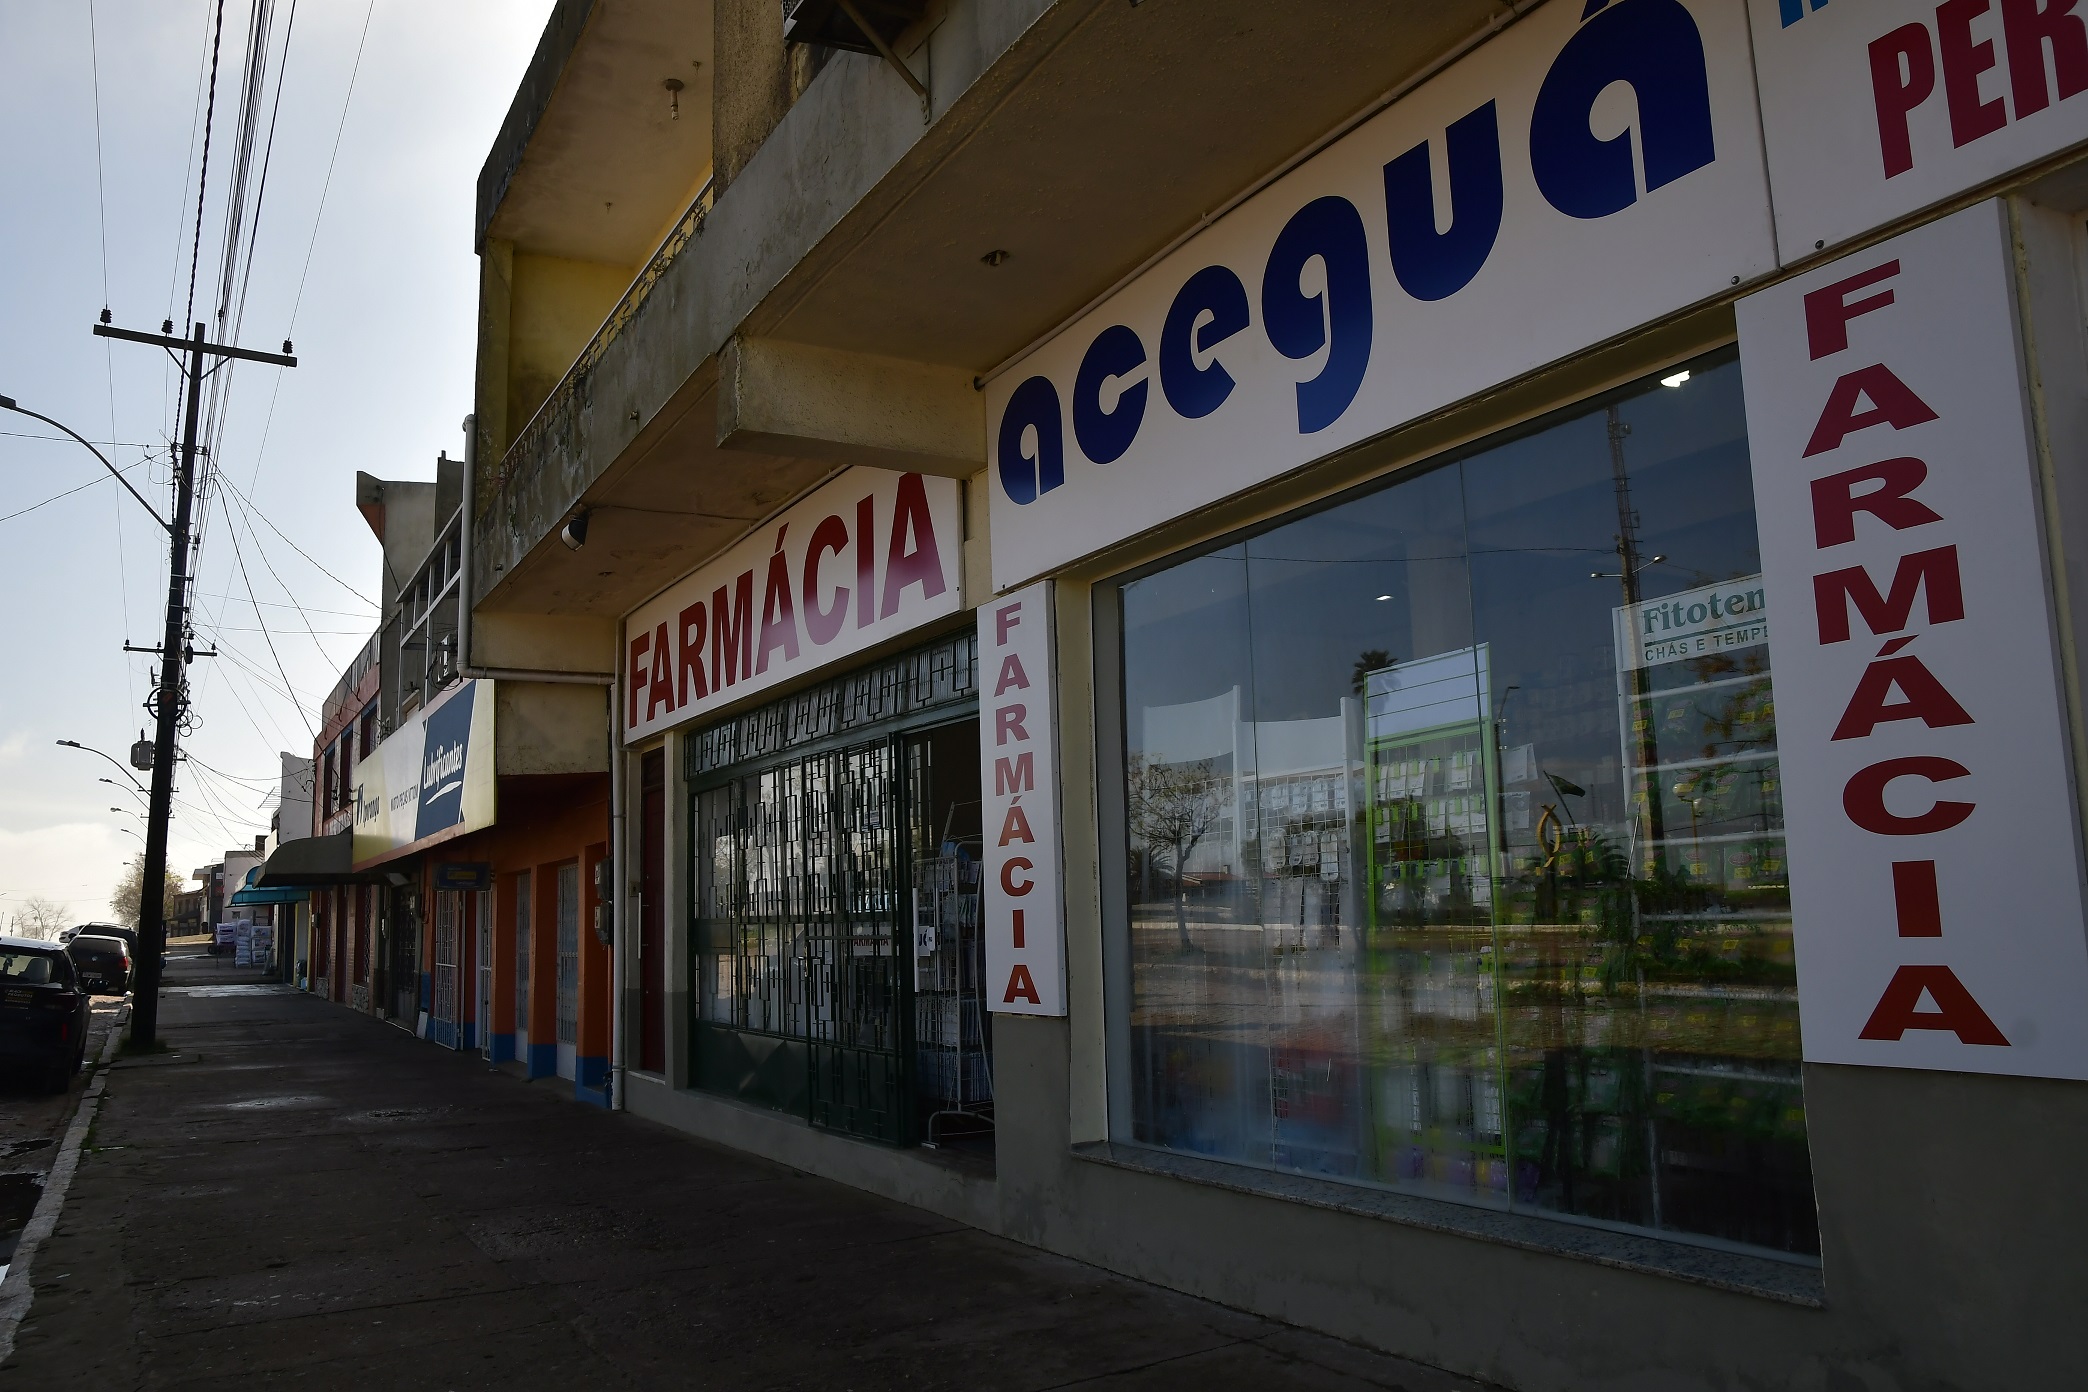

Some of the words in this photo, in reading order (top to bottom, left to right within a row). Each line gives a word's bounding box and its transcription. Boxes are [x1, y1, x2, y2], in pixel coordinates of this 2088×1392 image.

[998, 0, 1716, 506] aceguá
[423, 739, 463, 791] Lubrificantes
[629, 472, 946, 729] FARMÁCIA
[1645, 641, 1688, 662] CHÁS
[1697, 638, 1706, 652] E
[1802, 258, 2012, 1046] FARMÁCIA
[994, 601, 1041, 1004] FARMÁCIA
